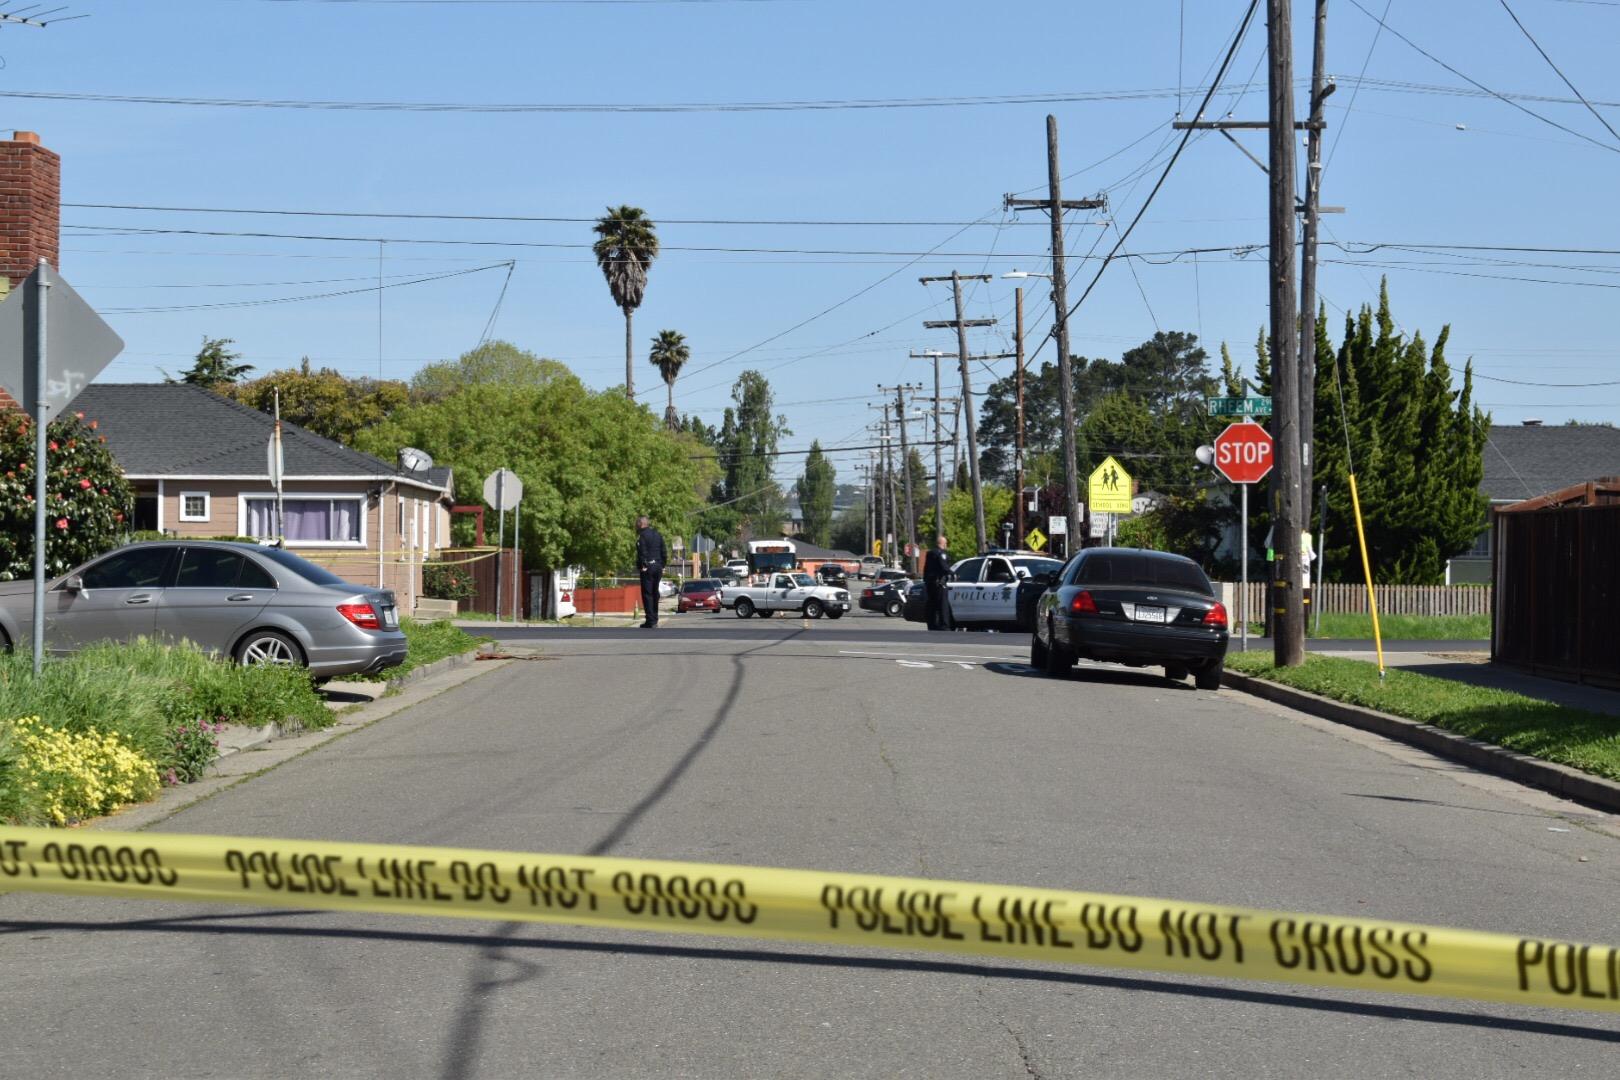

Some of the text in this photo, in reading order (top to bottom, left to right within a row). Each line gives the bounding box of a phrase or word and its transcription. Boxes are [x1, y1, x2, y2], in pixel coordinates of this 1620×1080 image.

[1210, 400, 1253, 413] RHEEM
[1219, 442, 1270, 464] STOP
[954, 591, 1000, 601] POLICE
[226, 849, 758, 924] POLICE LINE DO NOT CROSS
[820, 884, 1434, 984] POLICE LINE DO NOT CROSS
[1516, 939, 1620, 1000] POLI
